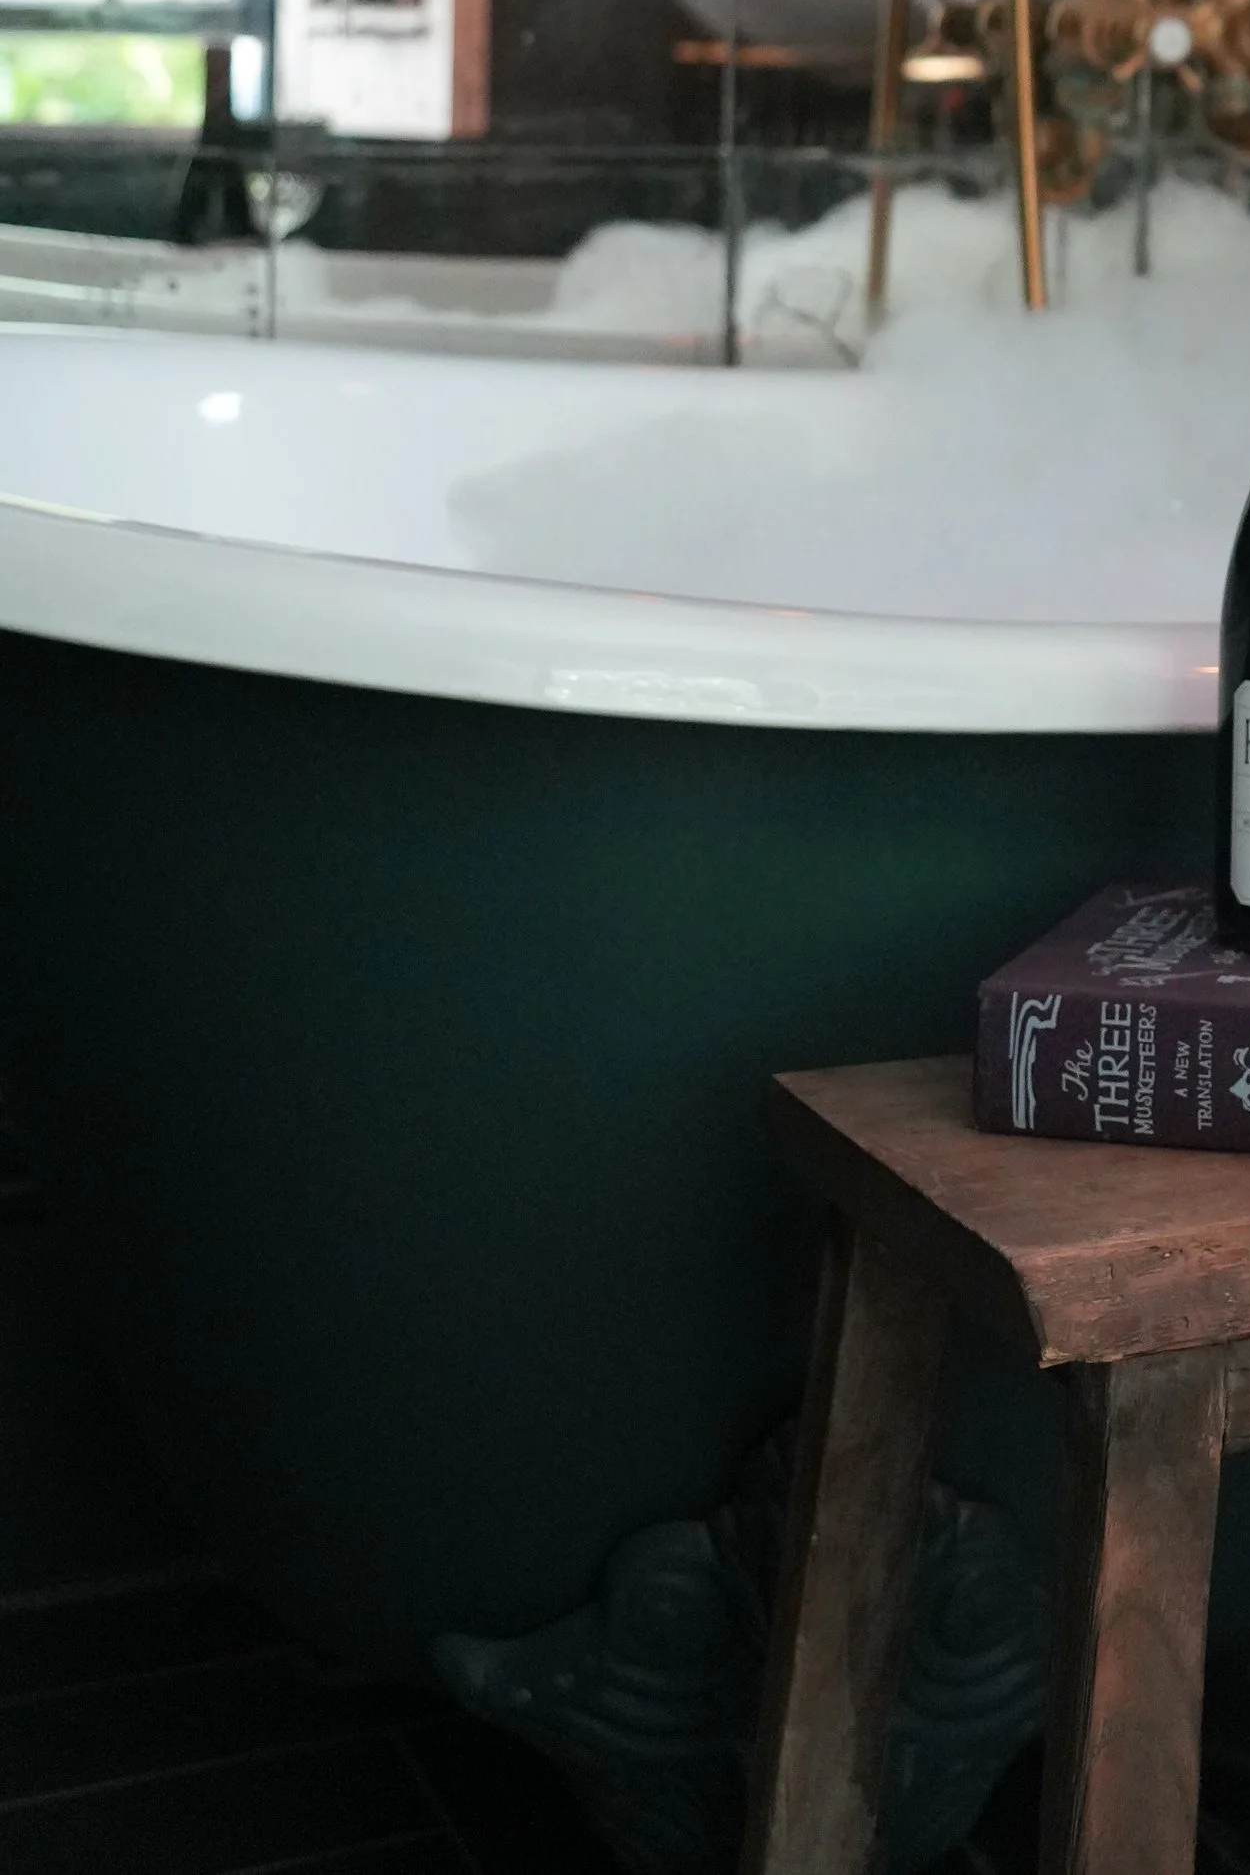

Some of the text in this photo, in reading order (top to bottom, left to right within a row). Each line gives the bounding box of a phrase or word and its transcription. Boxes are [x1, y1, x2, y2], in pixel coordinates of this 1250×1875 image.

[1061, 1039, 1093, 1102] The
[1093, 1001, 1132, 1132] THREE
[1133, 1003, 1157, 1135] MUSKETEERS
[1174, 1040, 1191, 1098] A NEW
[1197, 1020, 1213, 1130] TRANSLATION
